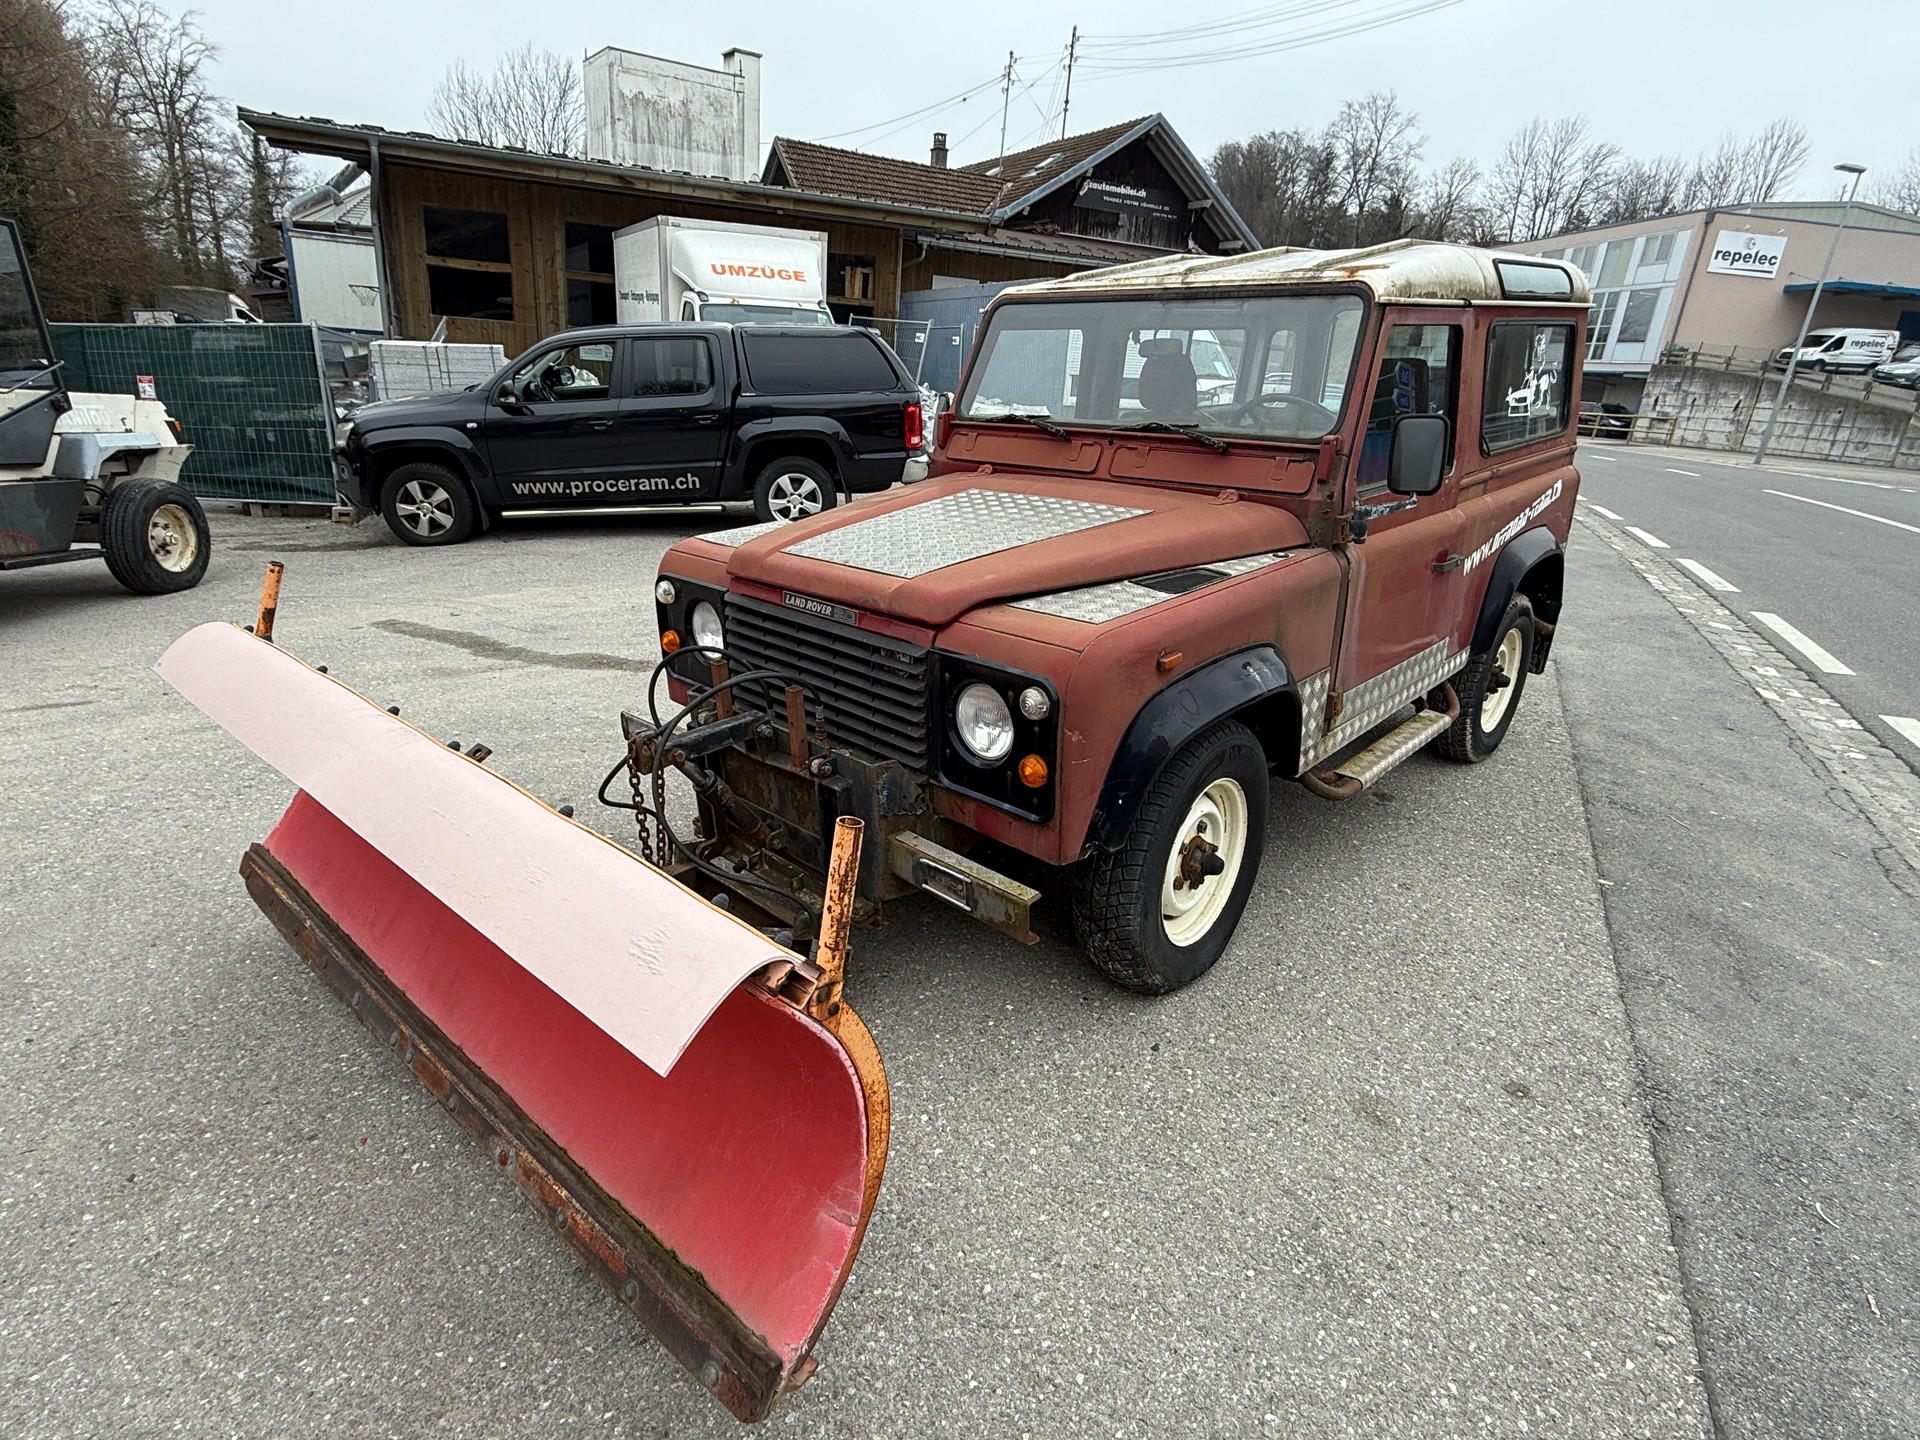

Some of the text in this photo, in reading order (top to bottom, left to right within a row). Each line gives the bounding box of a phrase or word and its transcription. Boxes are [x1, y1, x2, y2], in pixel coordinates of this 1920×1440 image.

[1713, 249, 1778, 267] repelec
[711, 263, 807, 283] UMZÜGE
[1850, 339, 1886, 350] repelec
[512, 472, 700, 497] www.proceram.ch
[785, 594, 806, 608] LAND
[806, 600, 832, 616] ROVER
